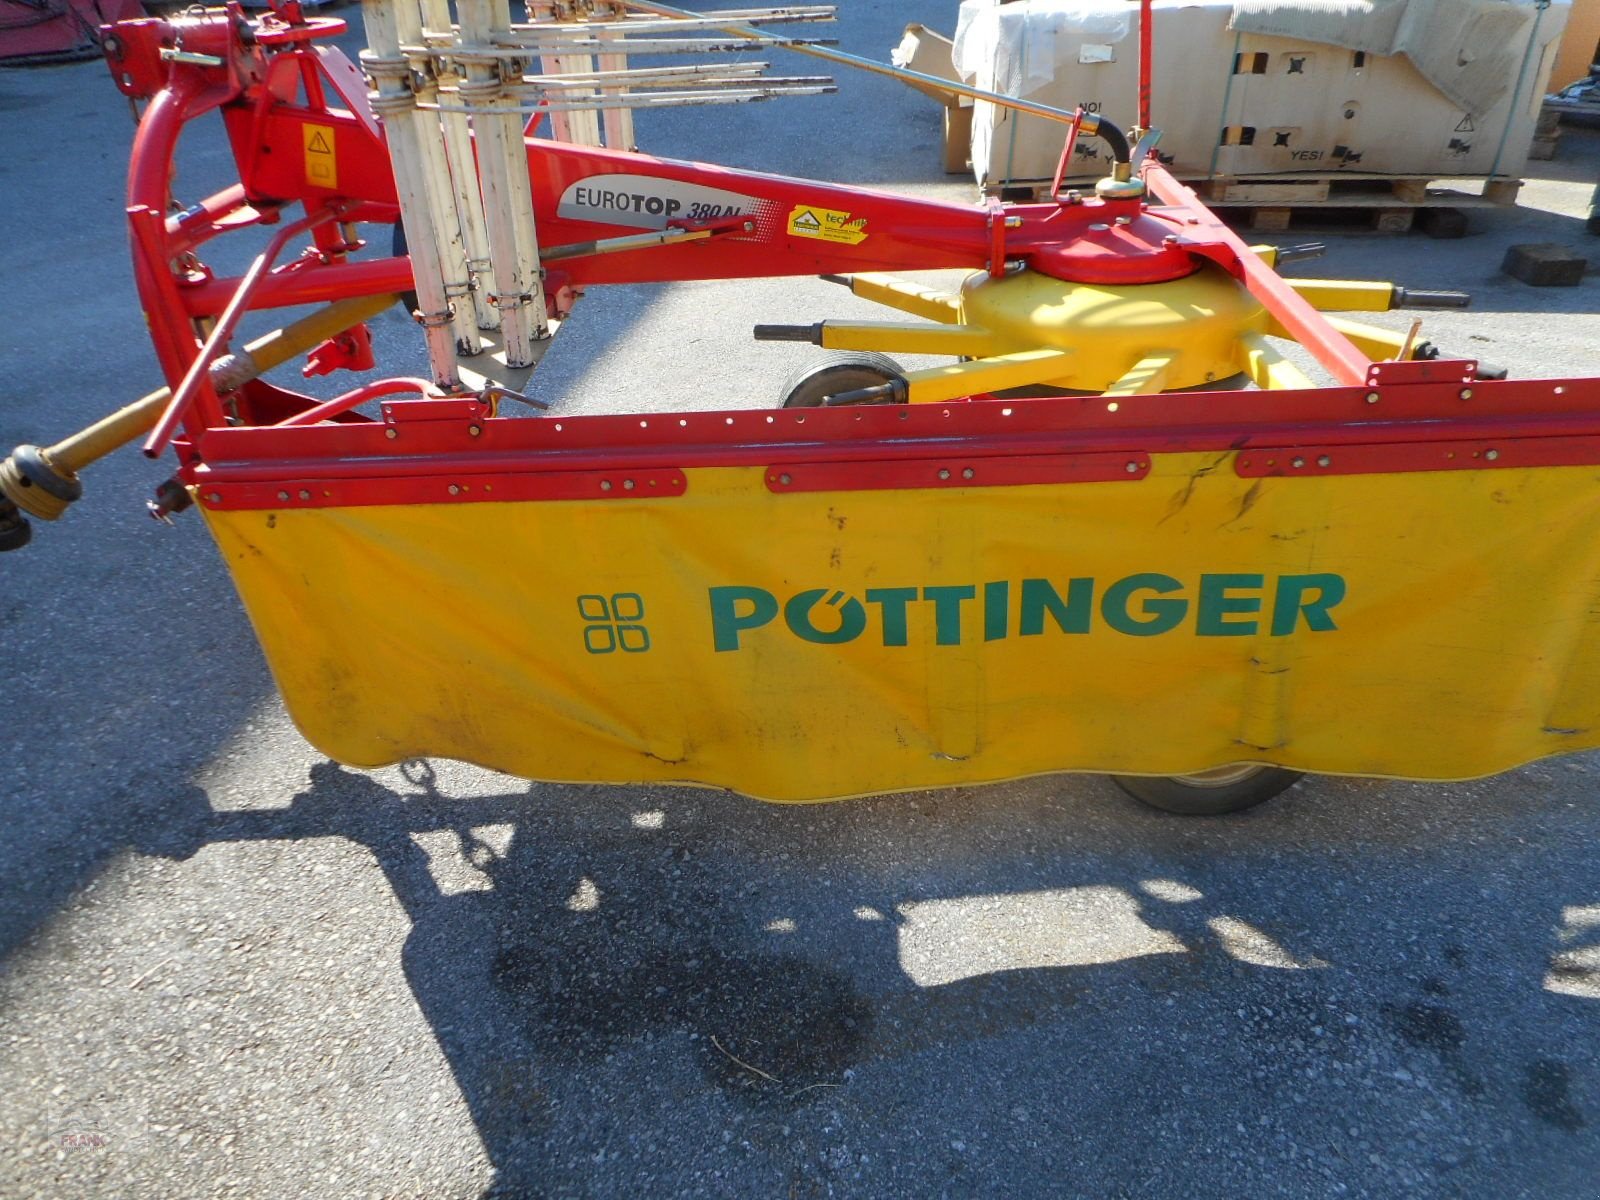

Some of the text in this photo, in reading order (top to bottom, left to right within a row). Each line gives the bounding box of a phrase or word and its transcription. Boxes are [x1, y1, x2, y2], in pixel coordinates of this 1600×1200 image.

[1079, 102, 1102, 113] NO!
[1291, 150, 1324, 161] YES!
[576, 187, 681, 217] EUROTOP
[686, 202, 722, 219] 380
[709, 573, 1346, 651] PÖTTINGER
